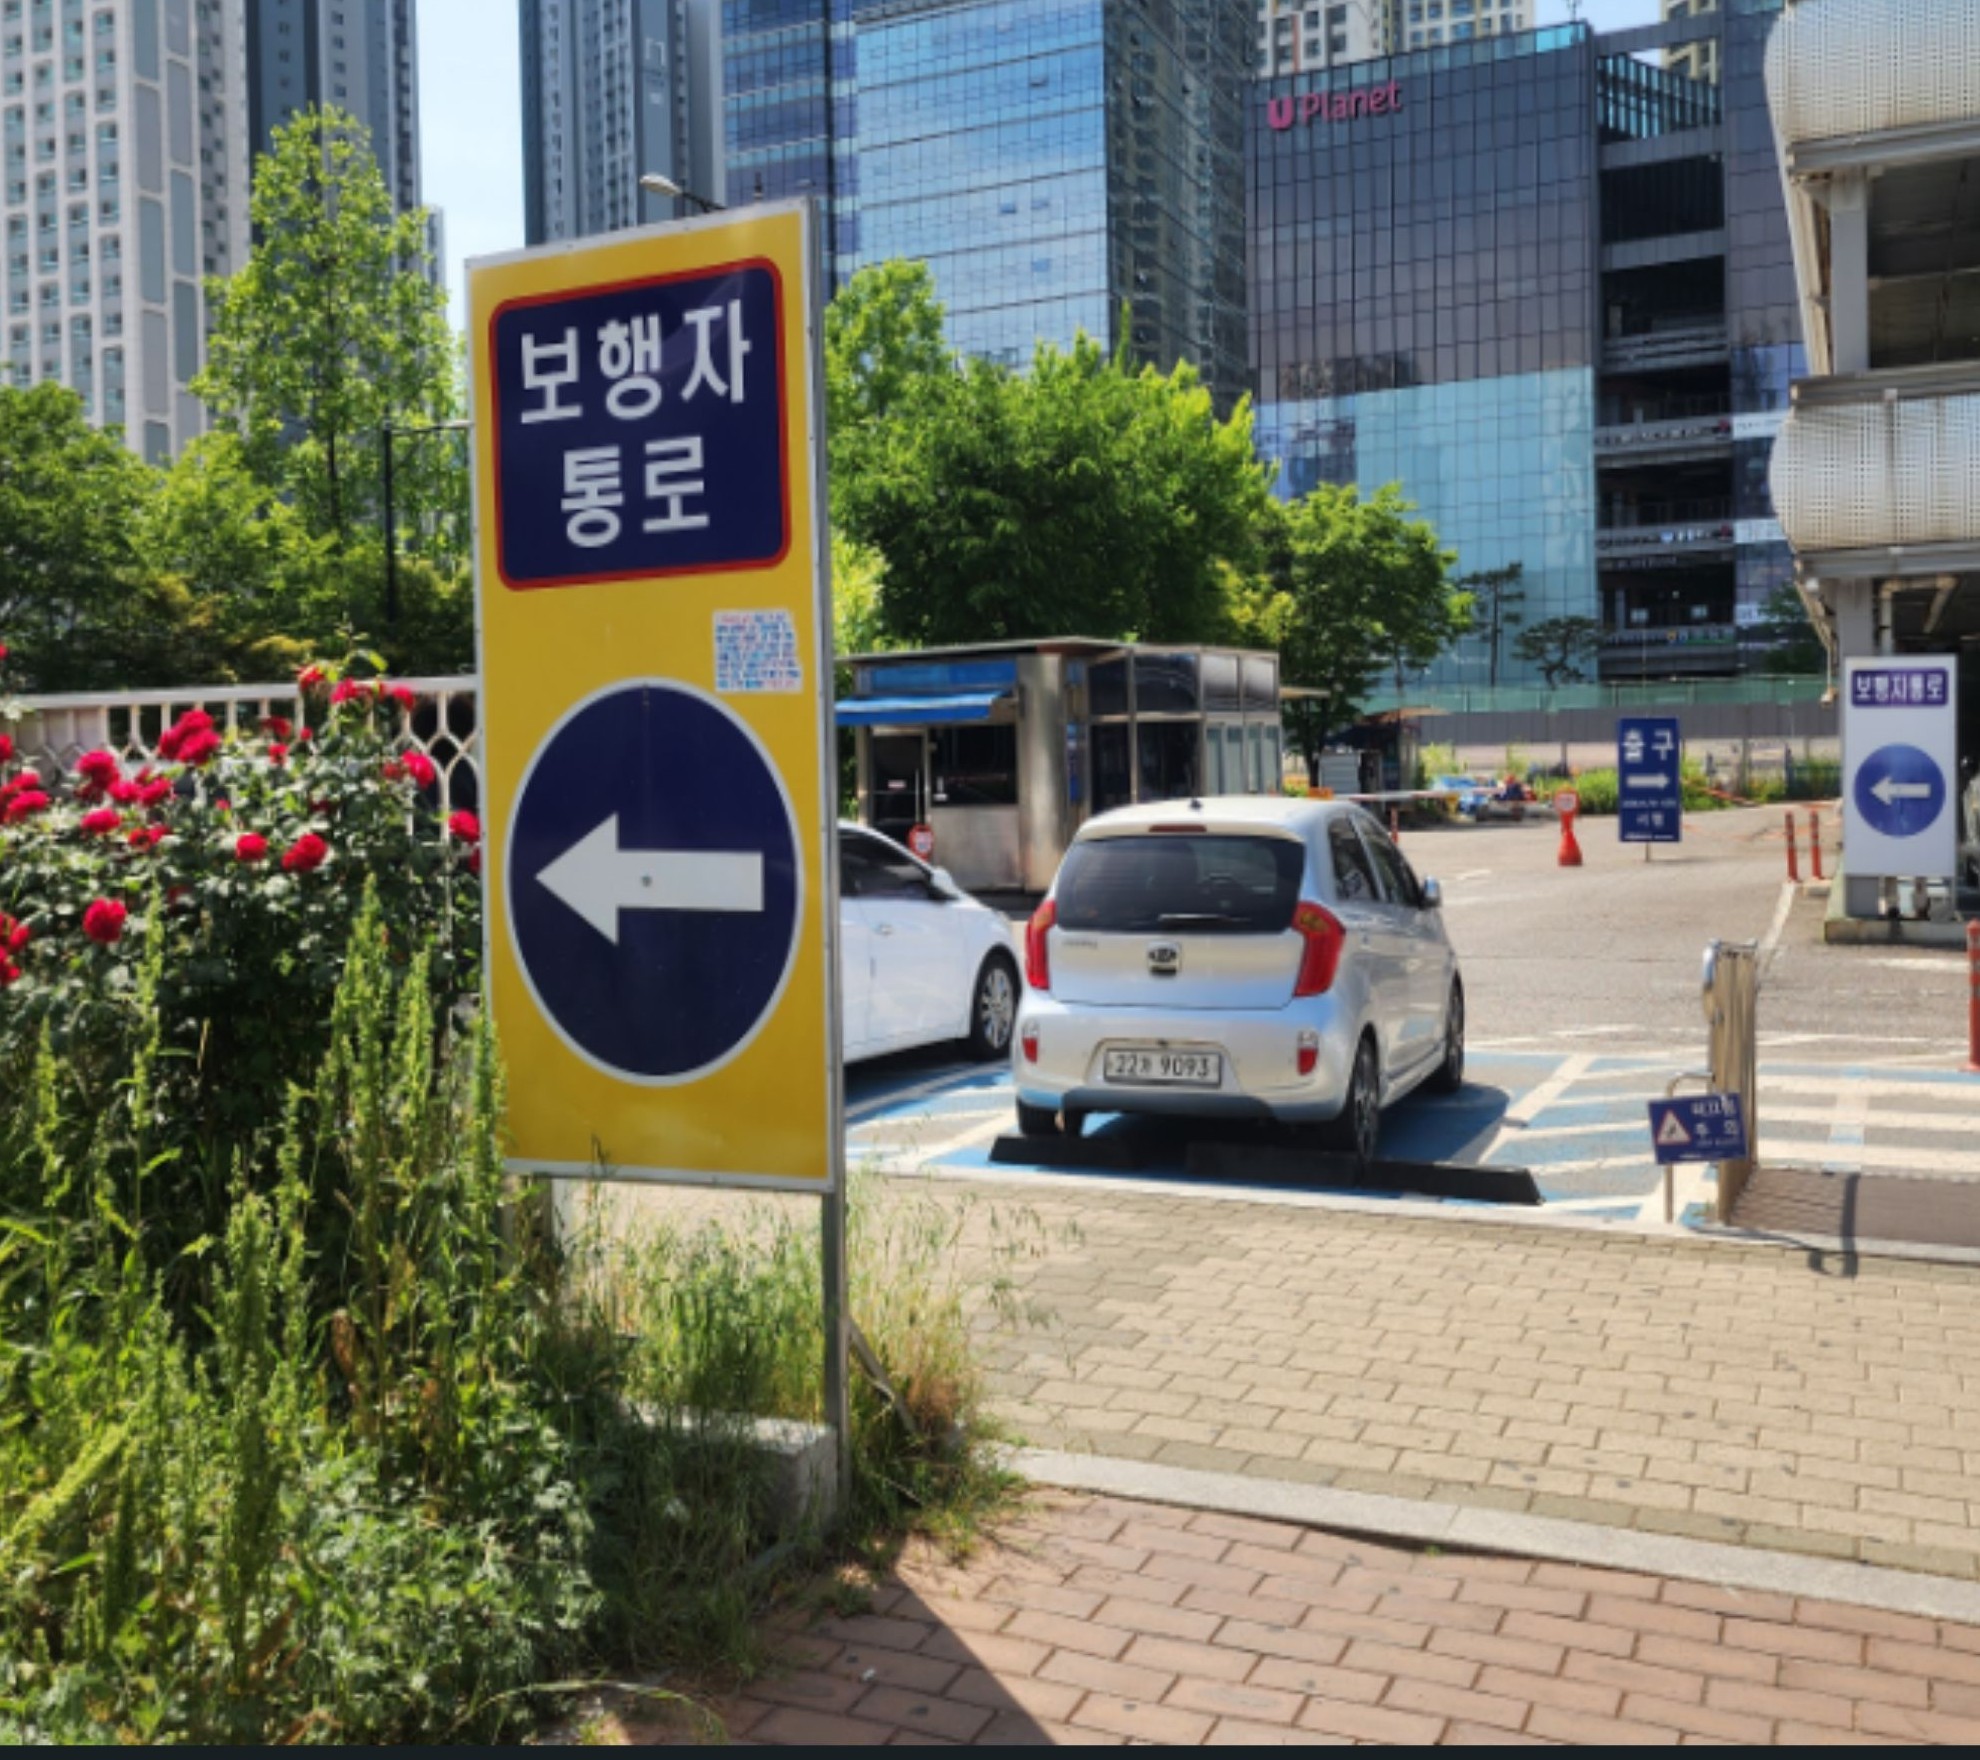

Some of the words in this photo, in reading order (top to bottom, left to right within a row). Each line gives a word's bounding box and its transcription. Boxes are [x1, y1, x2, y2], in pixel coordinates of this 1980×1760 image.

[1267, 96, 1294, 130] U
[1302, 79, 1402, 124] Planet
[520, 299, 751, 424] 보행자
[560, 435, 710, 548] 통로
[1160, 1055, 1210, 1077] 9093
